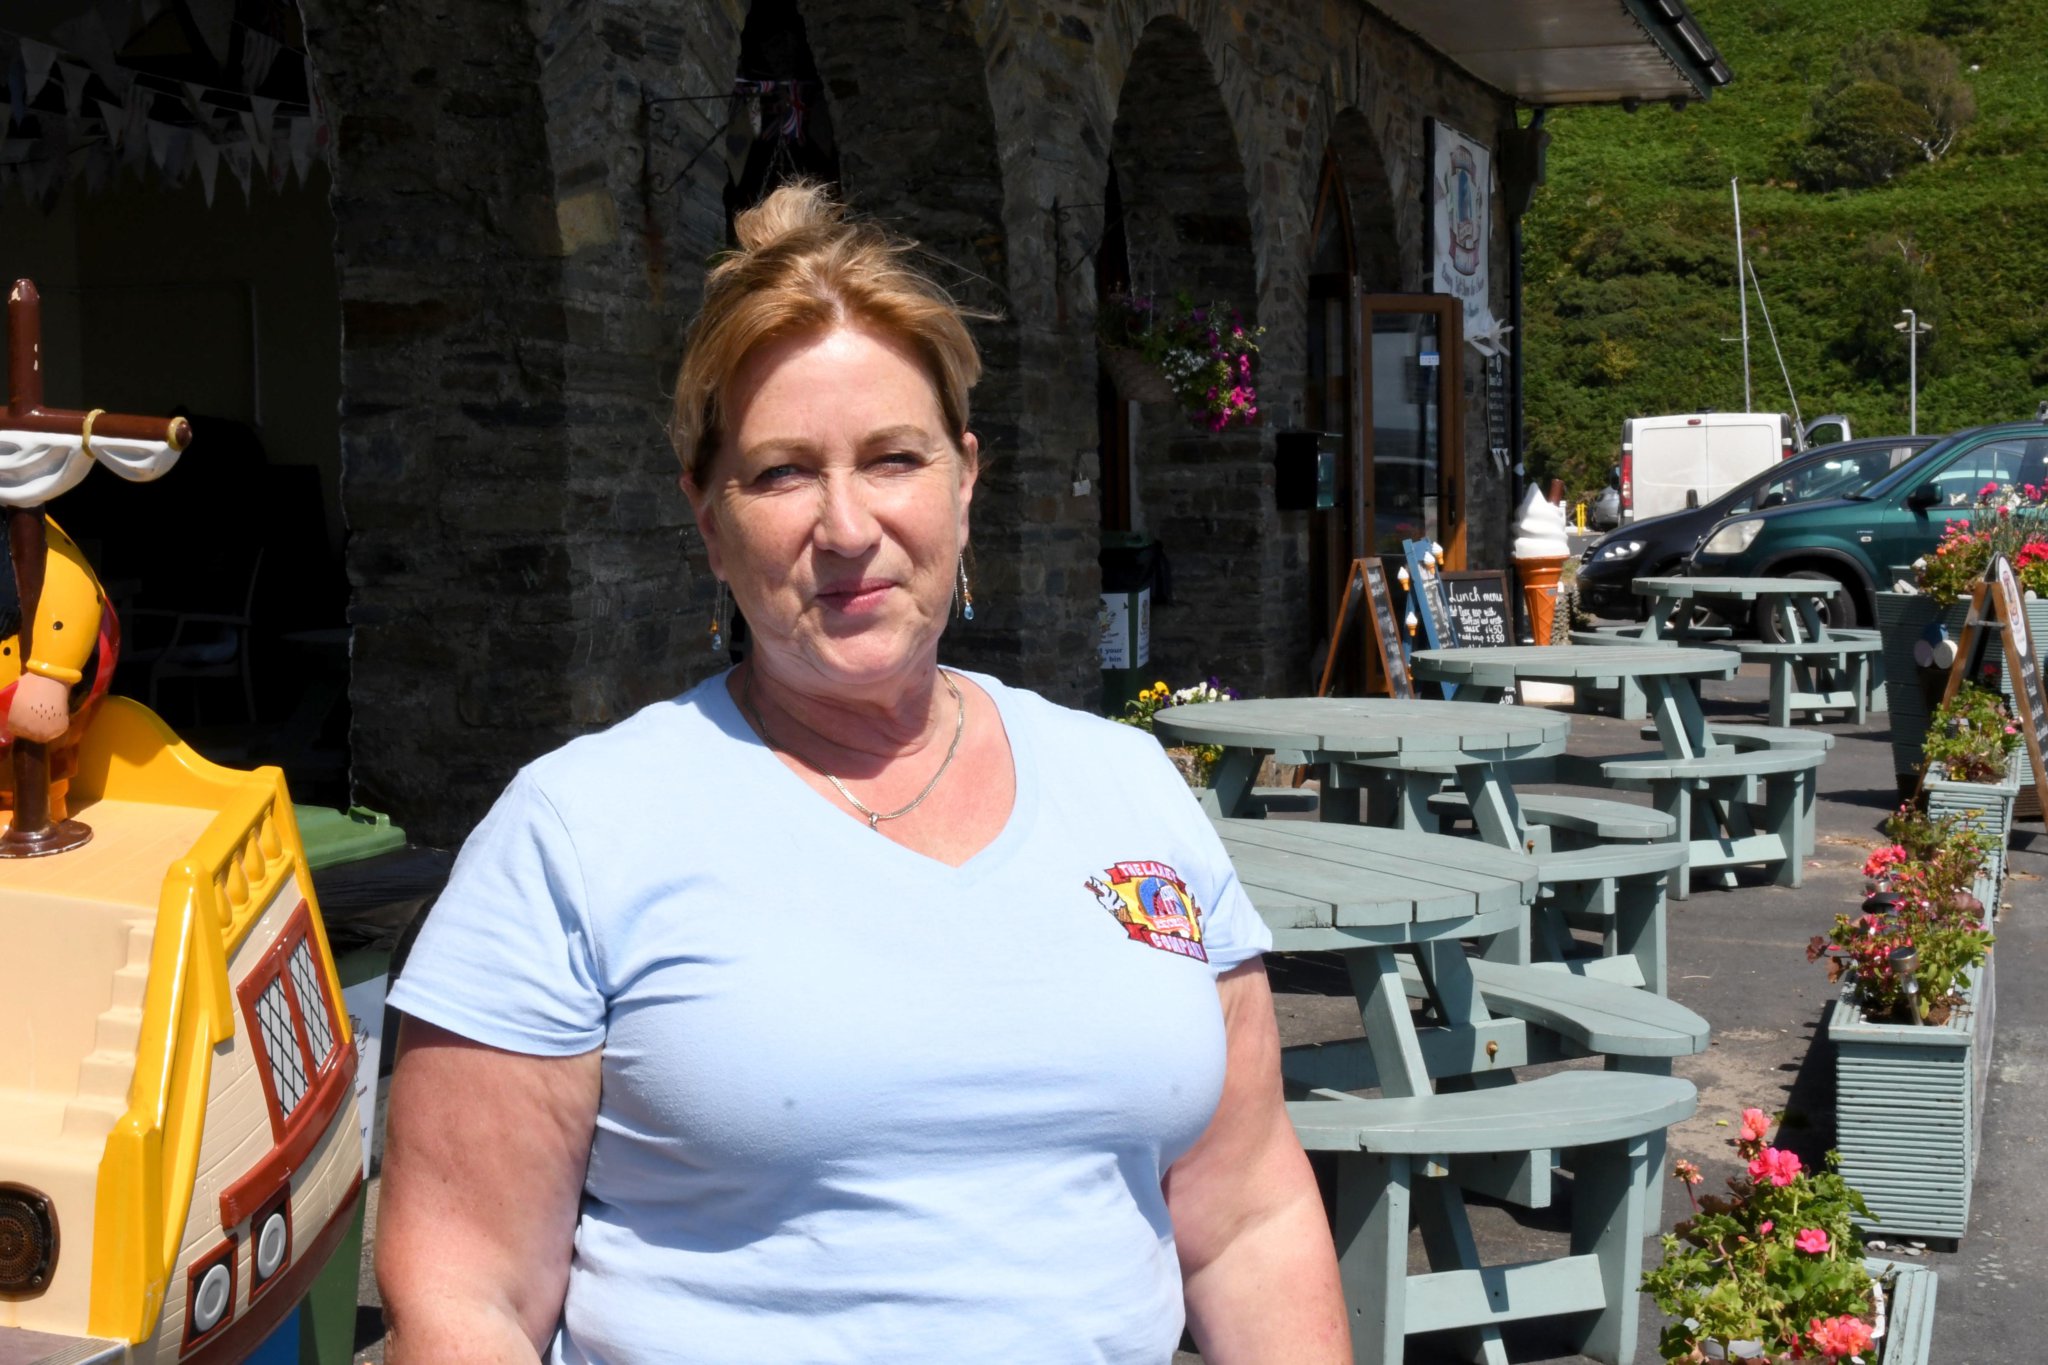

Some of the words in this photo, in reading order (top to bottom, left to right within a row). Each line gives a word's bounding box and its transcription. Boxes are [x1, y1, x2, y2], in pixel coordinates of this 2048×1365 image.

[1449, 581, 1481, 603] Lunch
[1482, 592, 1504, 602] menu
[1117, 863, 1143, 876] THE
